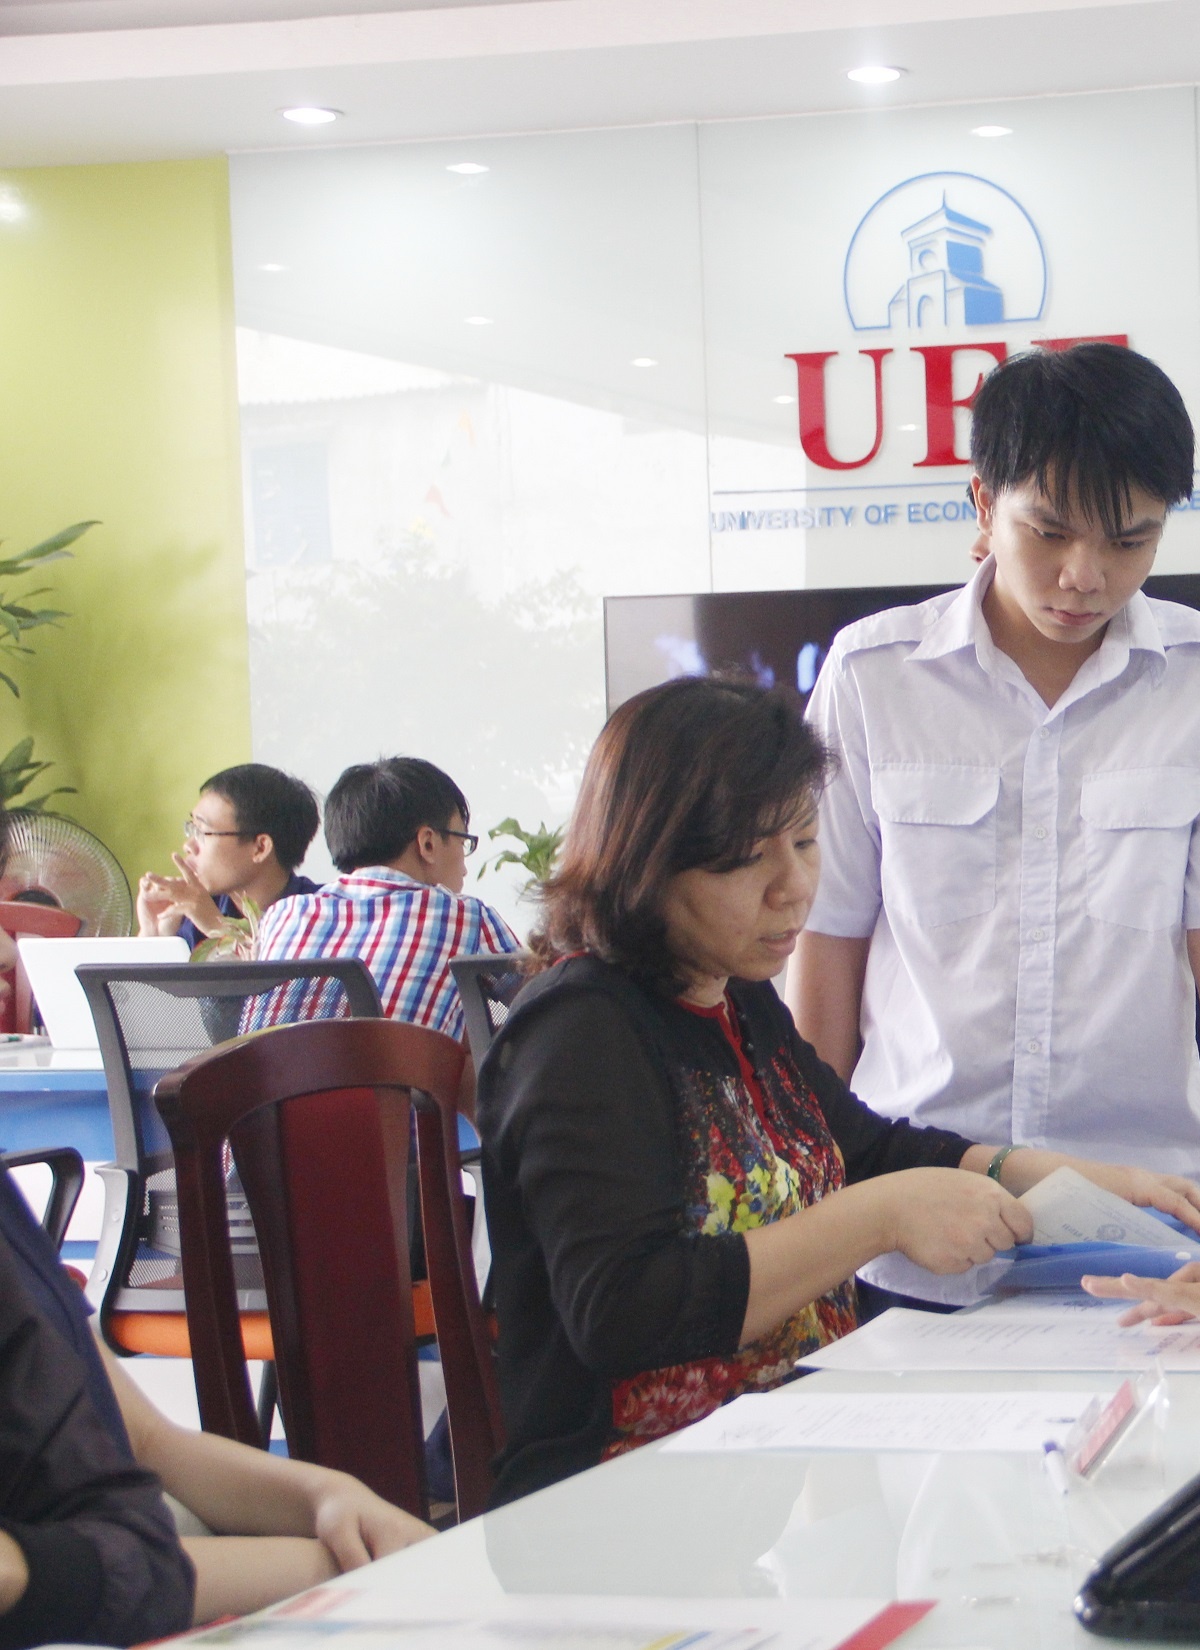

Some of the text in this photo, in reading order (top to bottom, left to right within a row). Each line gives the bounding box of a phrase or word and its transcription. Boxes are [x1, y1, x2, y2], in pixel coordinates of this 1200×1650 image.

[784, 334, 1130, 471] UE
[709, 506, 854, 532] UNIVERSITY
[865, 504, 899, 525] OF
